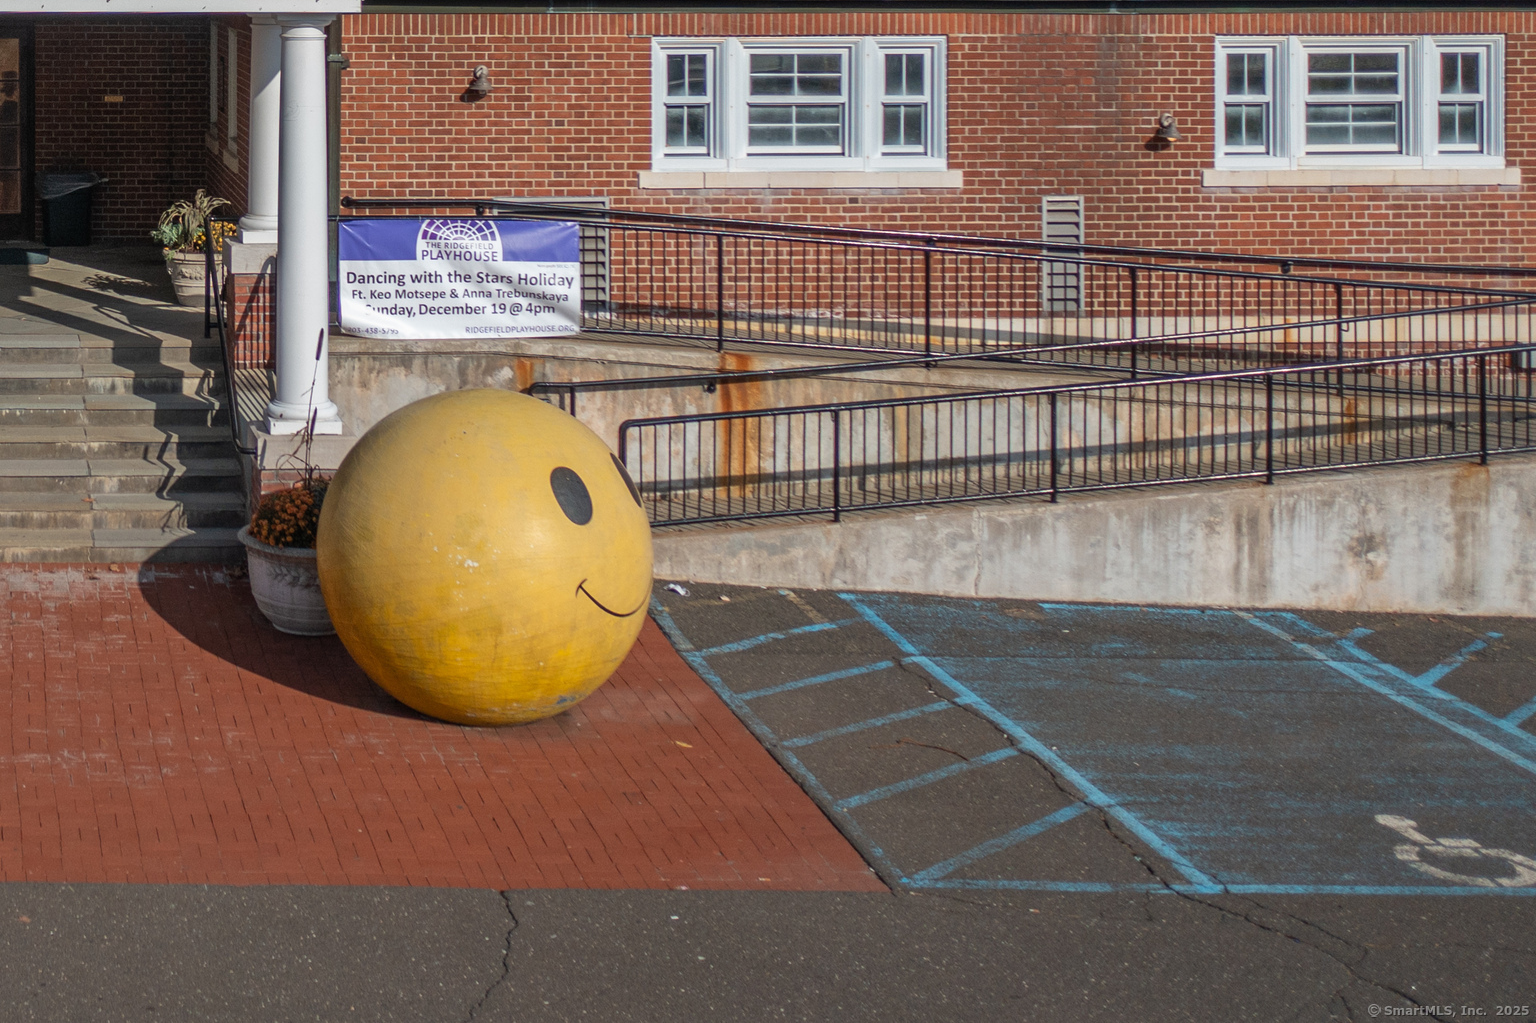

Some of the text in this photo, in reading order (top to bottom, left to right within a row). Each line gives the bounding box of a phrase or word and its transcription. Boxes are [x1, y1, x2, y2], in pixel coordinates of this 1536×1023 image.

[425, 241, 494, 250] THE RIDGEFIELD
[421, 249, 498, 262] PLAYHOUSE
[346, 269, 574, 289] Dancing with the Stars Holiday
[352, 288, 569, 304] Ft. Keo Motsepe & Anna Trebunskaya
[418, 303, 487, 316] December
[491, 303, 506, 315] 19
[509, 302, 523, 316] @
[525, 302, 556, 316] 4pm
[465, 325, 575, 334] RIDGEFIELDPLAYHOUSE.ORG
